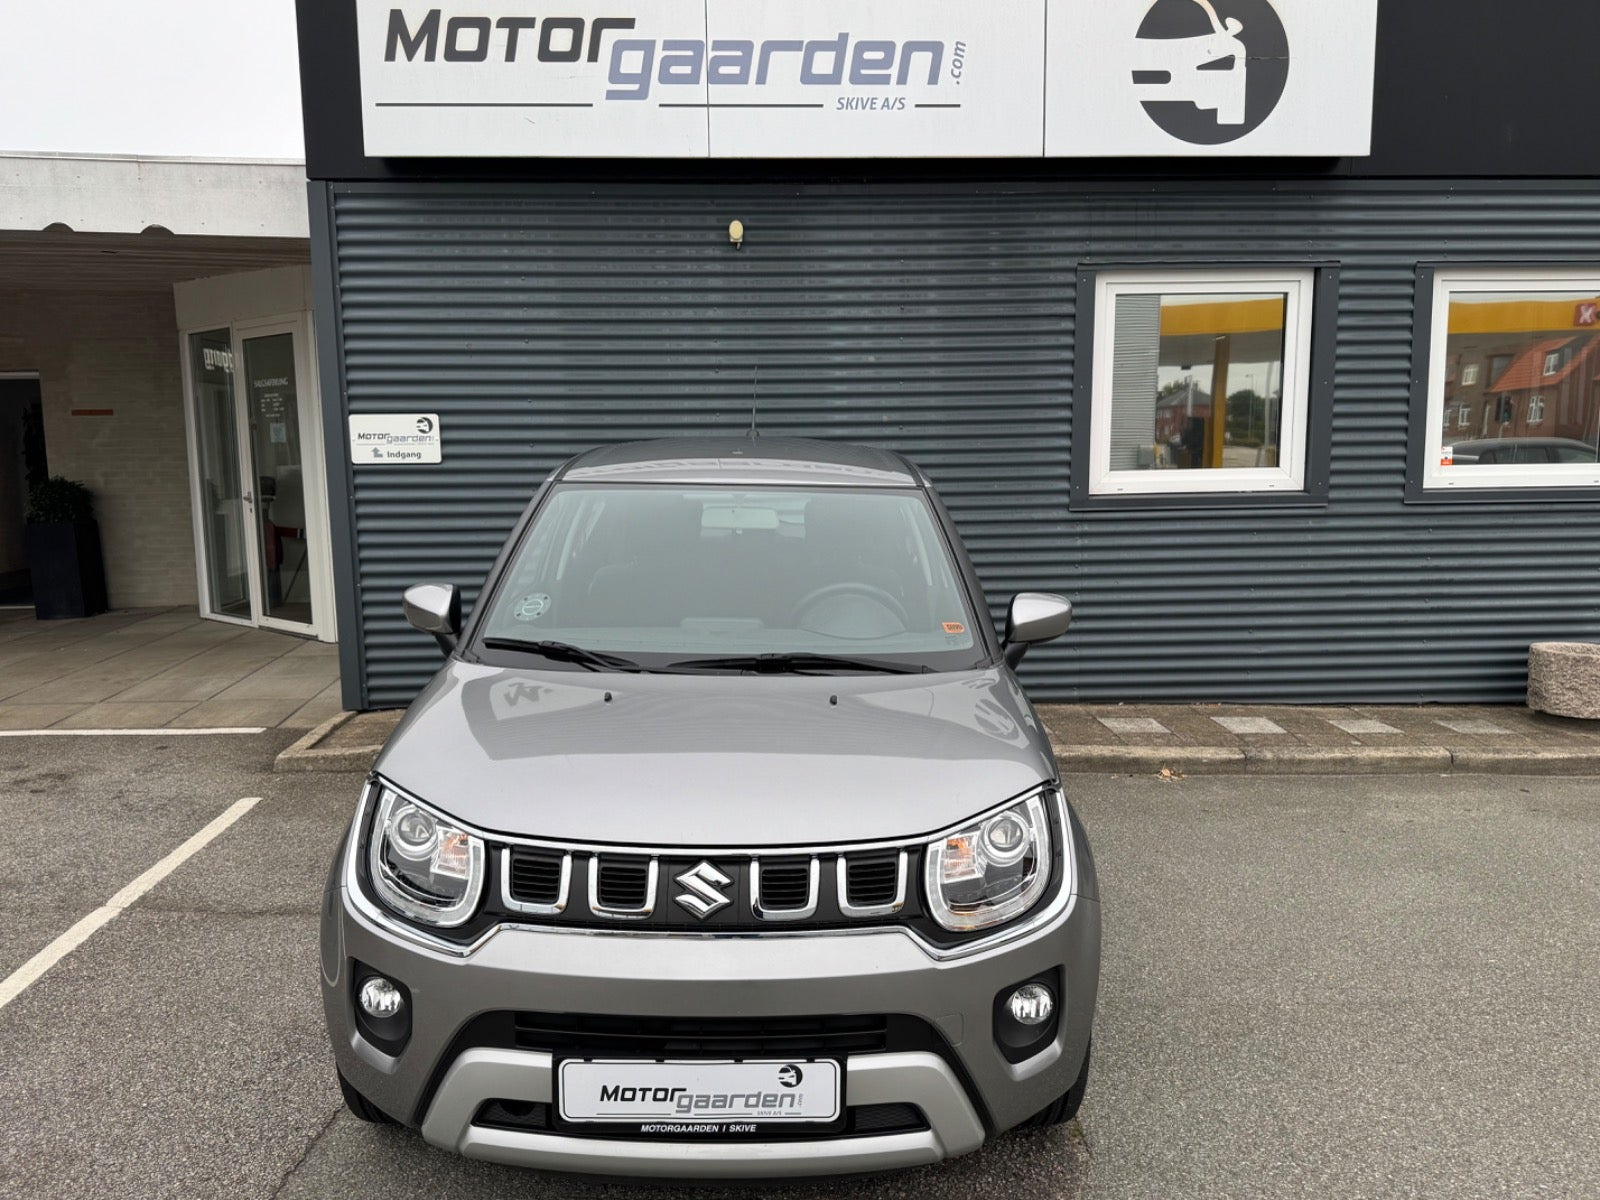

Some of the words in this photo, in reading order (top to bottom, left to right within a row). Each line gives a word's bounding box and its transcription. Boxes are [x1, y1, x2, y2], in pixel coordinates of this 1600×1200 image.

[950, 40, 967, 85] .com
[836, 96, 877, 111] SKIVE
[880, 96, 906, 111] A/S
[387, 451, 422, 460] Indgang
[641, 1124, 719, 1133] MOTORGAARDEN
[729, 1124, 757, 1133] SKIVE
